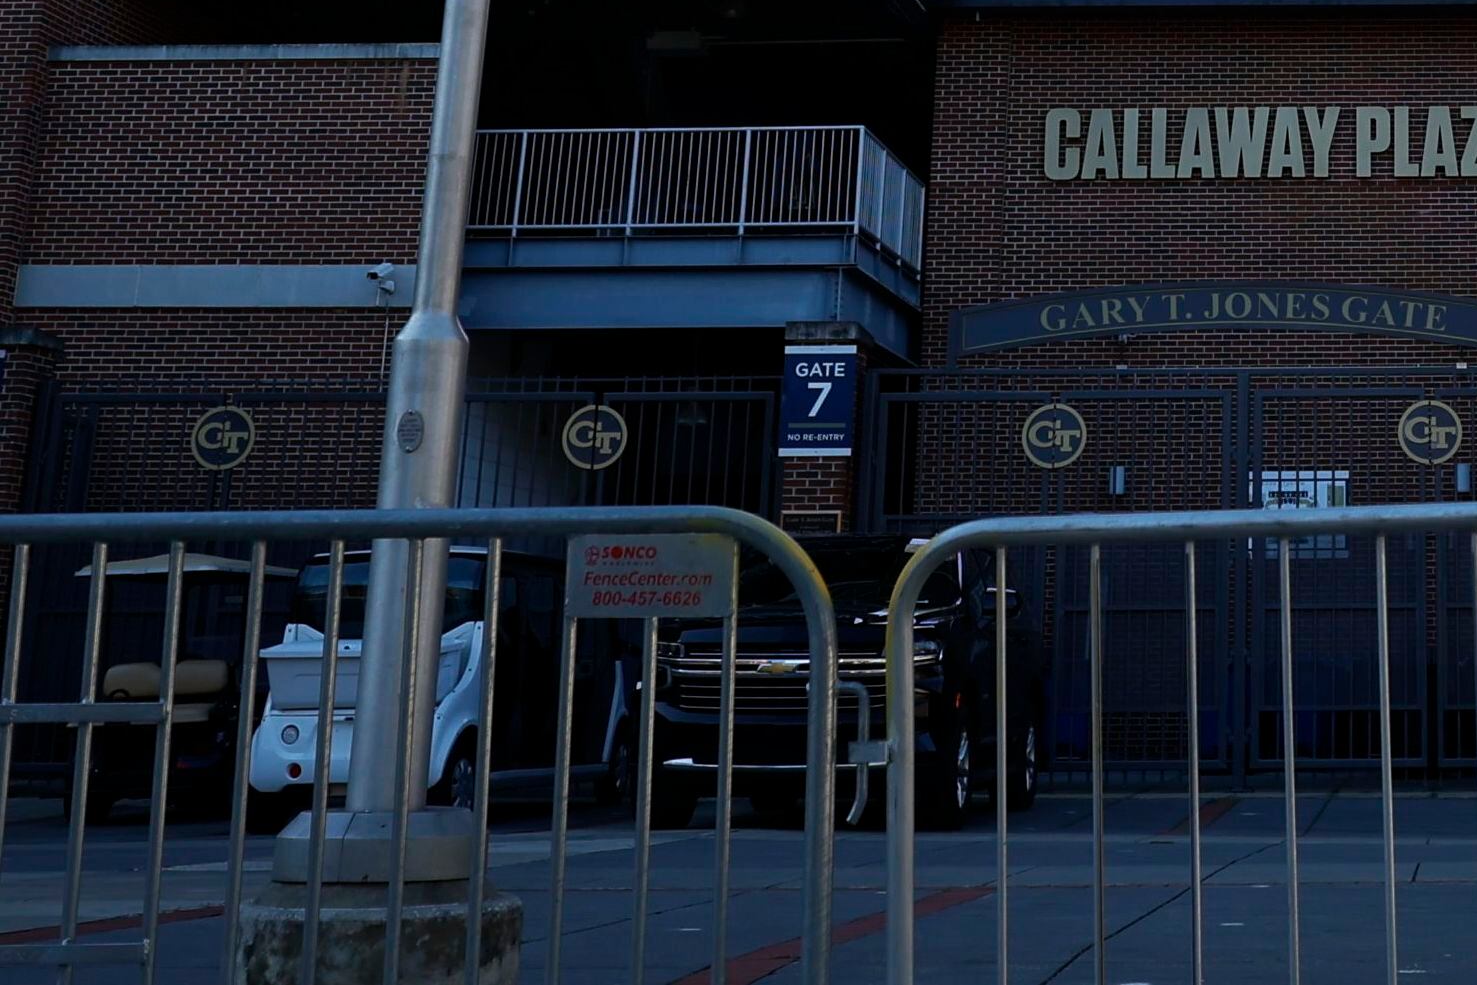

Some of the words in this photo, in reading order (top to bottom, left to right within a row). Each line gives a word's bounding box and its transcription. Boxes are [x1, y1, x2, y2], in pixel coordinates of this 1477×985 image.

[1043, 106, 1342, 181] CALLAWAY
[1039, 296, 1152, 332] GARY
[1160, 293, 1193, 320] T.
[1203, 291, 1332, 320] JONES
[1342, 295, 1449, 332] GATE
[795, 362, 846, 377] GATE
[807, 382, 832, 417] 7
[787, 433, 801, 441] NO
[803, 433, 845, 441] RE-ENTRY
[592, 591, 701, 606] 800-457-6626
